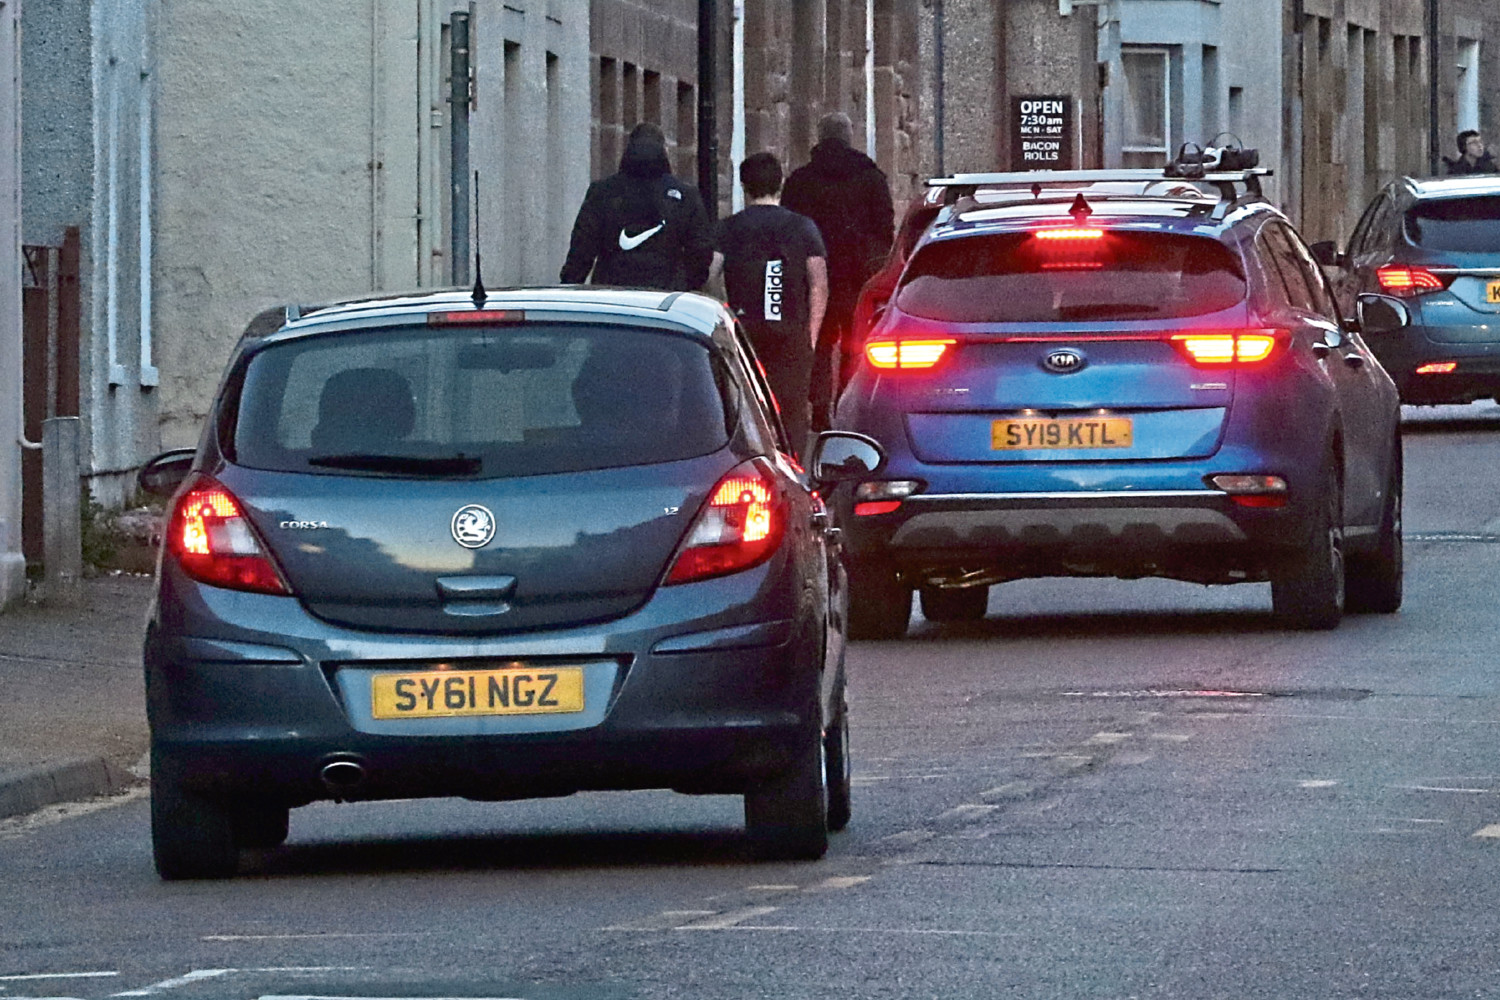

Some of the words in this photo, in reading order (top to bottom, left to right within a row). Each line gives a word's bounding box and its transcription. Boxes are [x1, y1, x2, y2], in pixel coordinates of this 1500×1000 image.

[1020, 101, 1063, 114] OPEN
[1022, 141, 1060, 151] BACON
[1024, 151, 1059, 161] ROLLS
[1050, 354, 1075, 367] KIA
[1006, 424, 1061, 446] SY19
[1068, 422, 1115, 445] KTL
[279, 520, 329, 530] CORSA
[394, 676, 478, 711] SY61
[488, 673, 559, 709] NGZ
